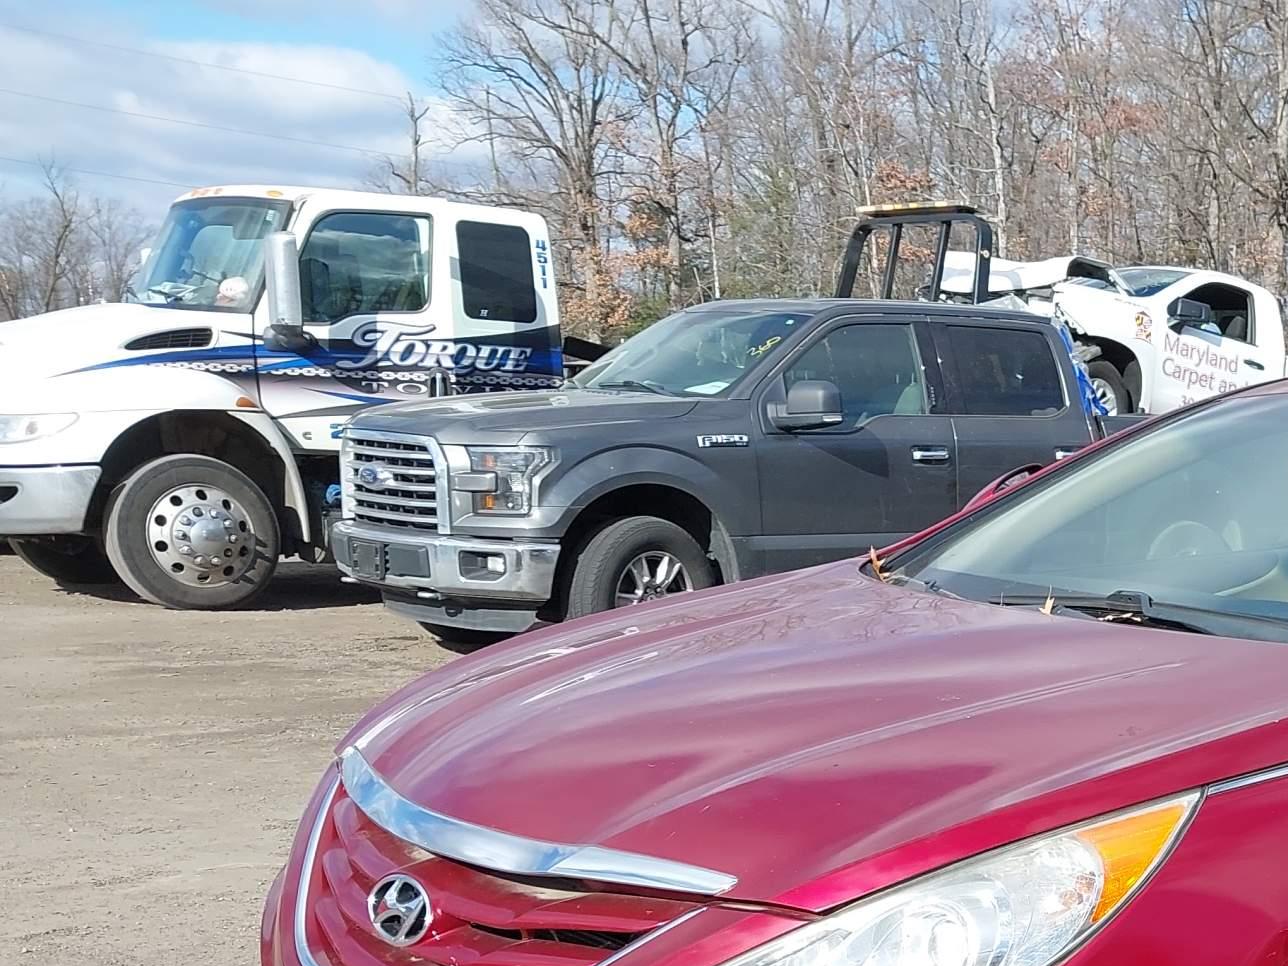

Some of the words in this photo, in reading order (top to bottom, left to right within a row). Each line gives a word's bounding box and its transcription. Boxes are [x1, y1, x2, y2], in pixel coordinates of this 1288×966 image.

[536, 240, 547, 288] 4511
[1164, 333, 1239, 374] Maryland
[1162, 358, 1215, 390] Carpet
[1218, 378, 1250, 393] an
